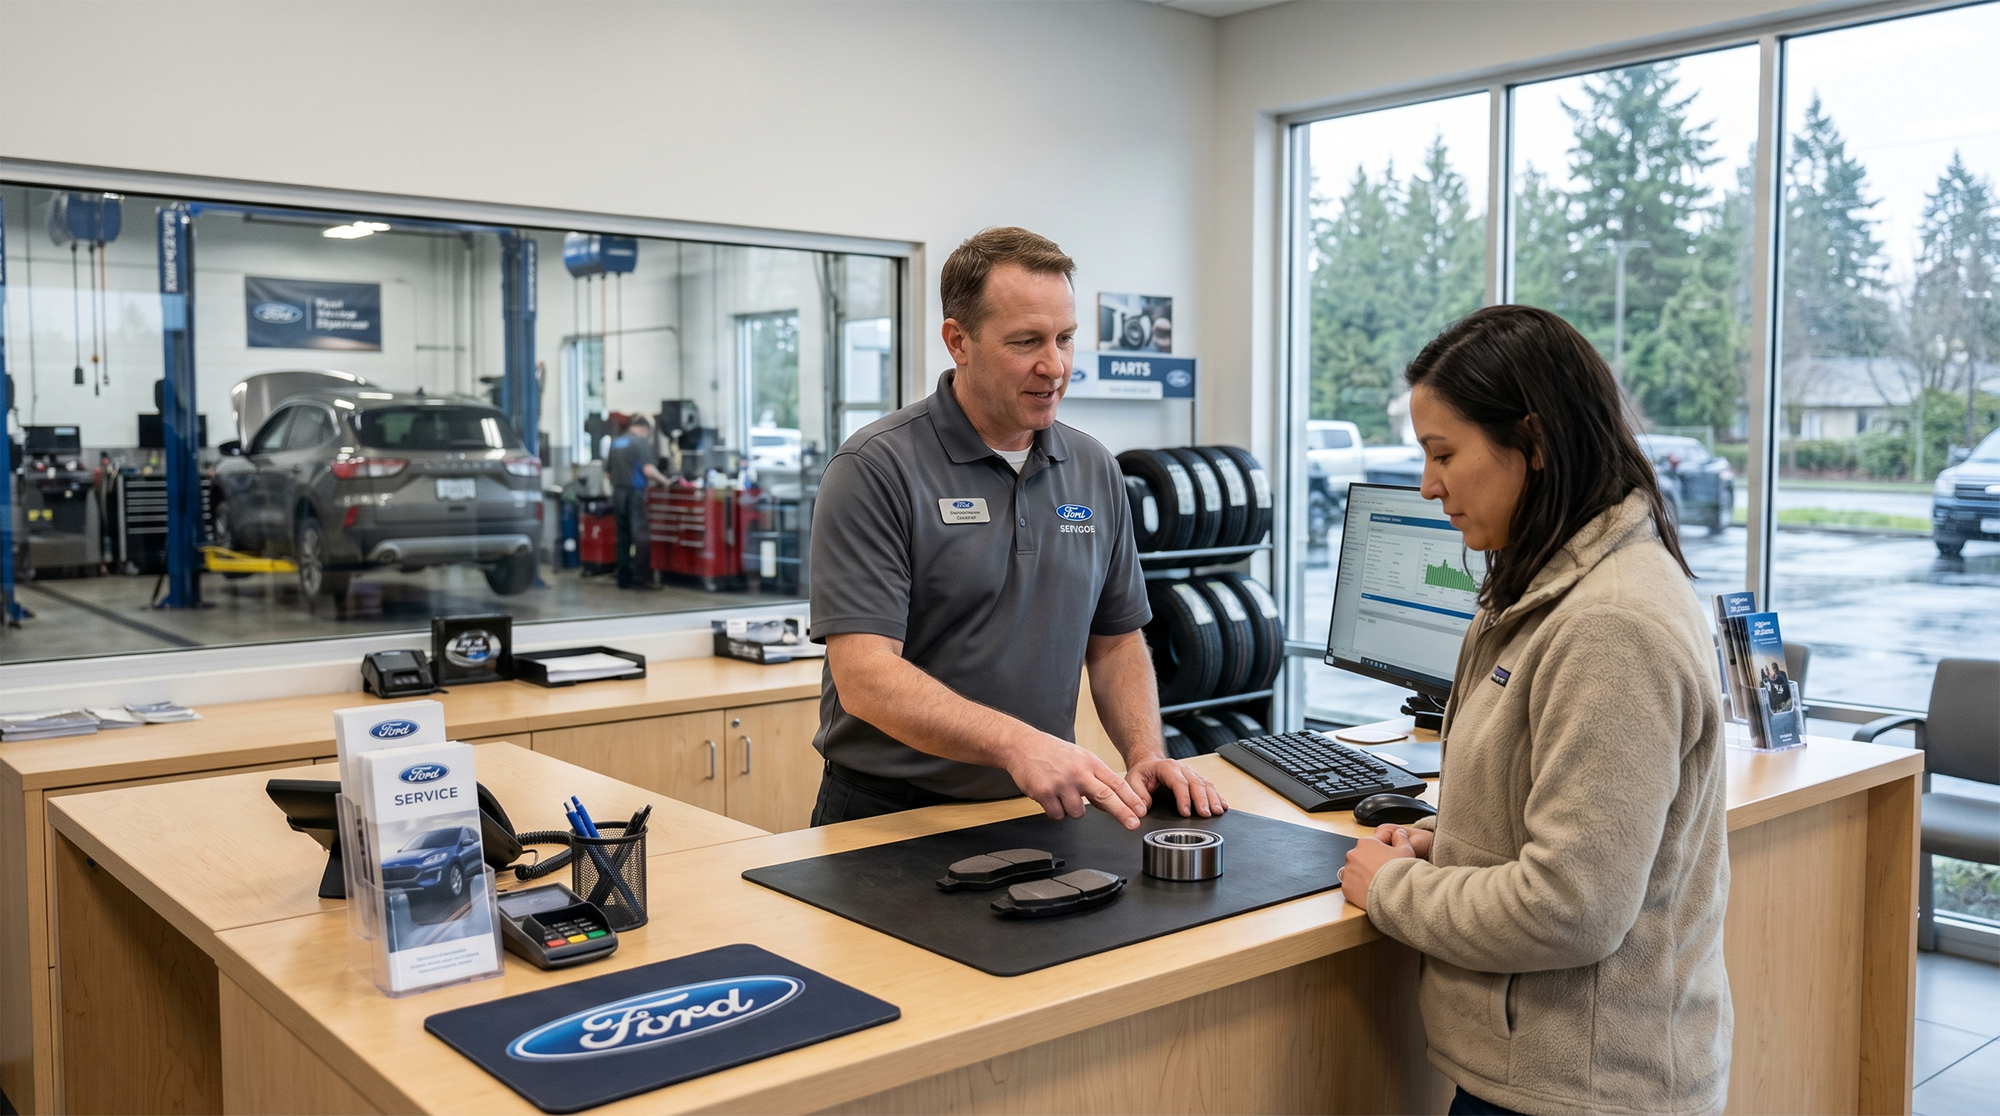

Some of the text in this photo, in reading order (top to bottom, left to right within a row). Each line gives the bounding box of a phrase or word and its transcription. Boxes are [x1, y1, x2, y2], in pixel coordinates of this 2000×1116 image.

[1110, 360, 1151, 377] PARTS
[378, 722, 411, 737] Ford
[408, 766, 441, 782] Ford
[394, 786, 458, 806] SERVICE
[579, 988, 754, 1050] Ford
